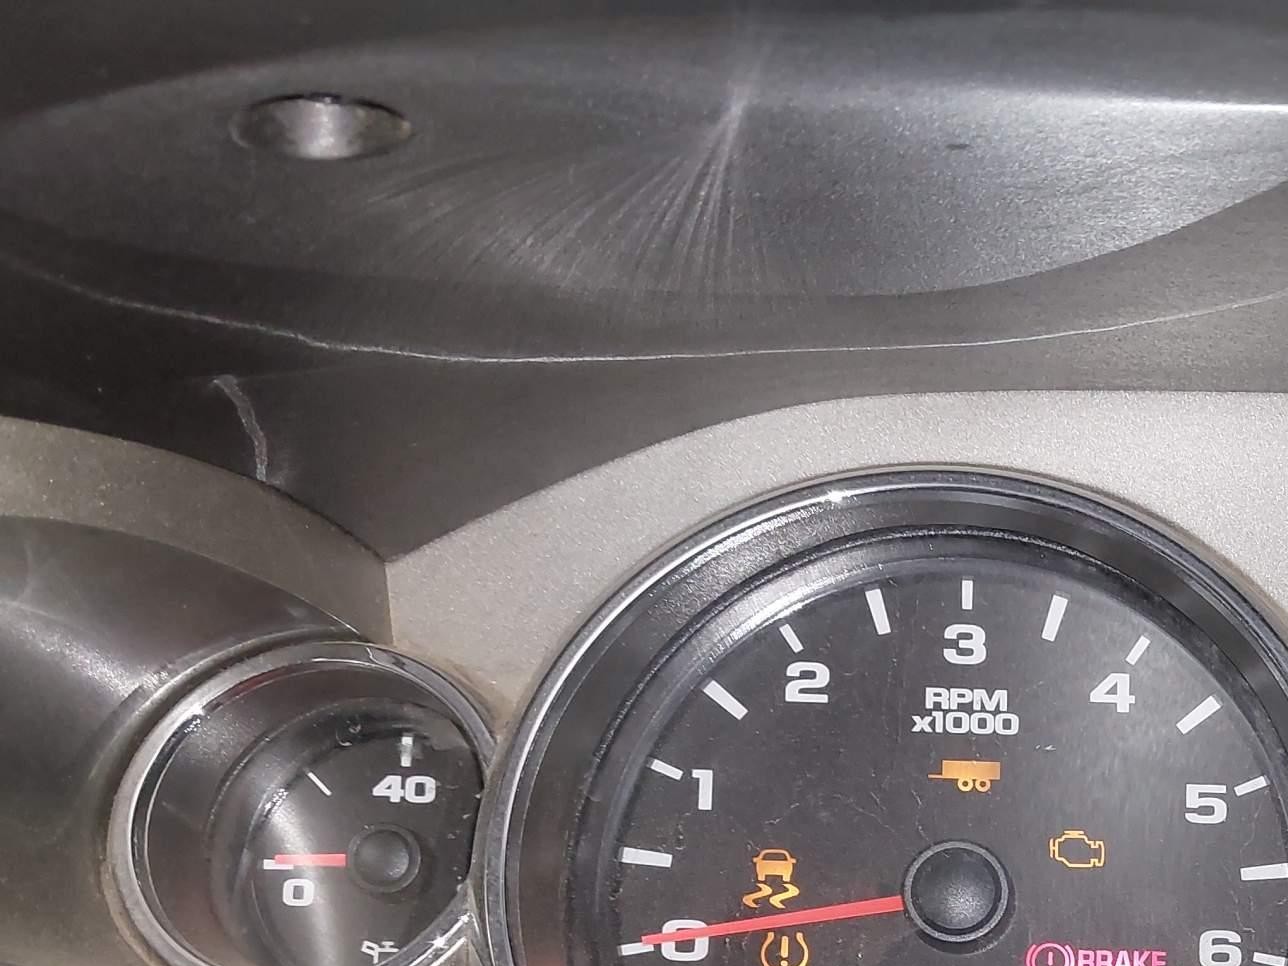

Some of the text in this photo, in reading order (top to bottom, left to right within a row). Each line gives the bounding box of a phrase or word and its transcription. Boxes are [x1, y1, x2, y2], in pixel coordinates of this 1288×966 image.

[943, 624, 987, 665] 3
[785, 661, 830, 703] 2
[925, 687, 1008, 712] RPM
[1089, 673, 1136, 713] 4
[911, 712, 1020, 735] x1000
[372, 774, 437, 804] 40
[692, 769, 713, 810] 1
[1184, 784, 1228, 824] 5
[282, 878, 315, 907] 0
